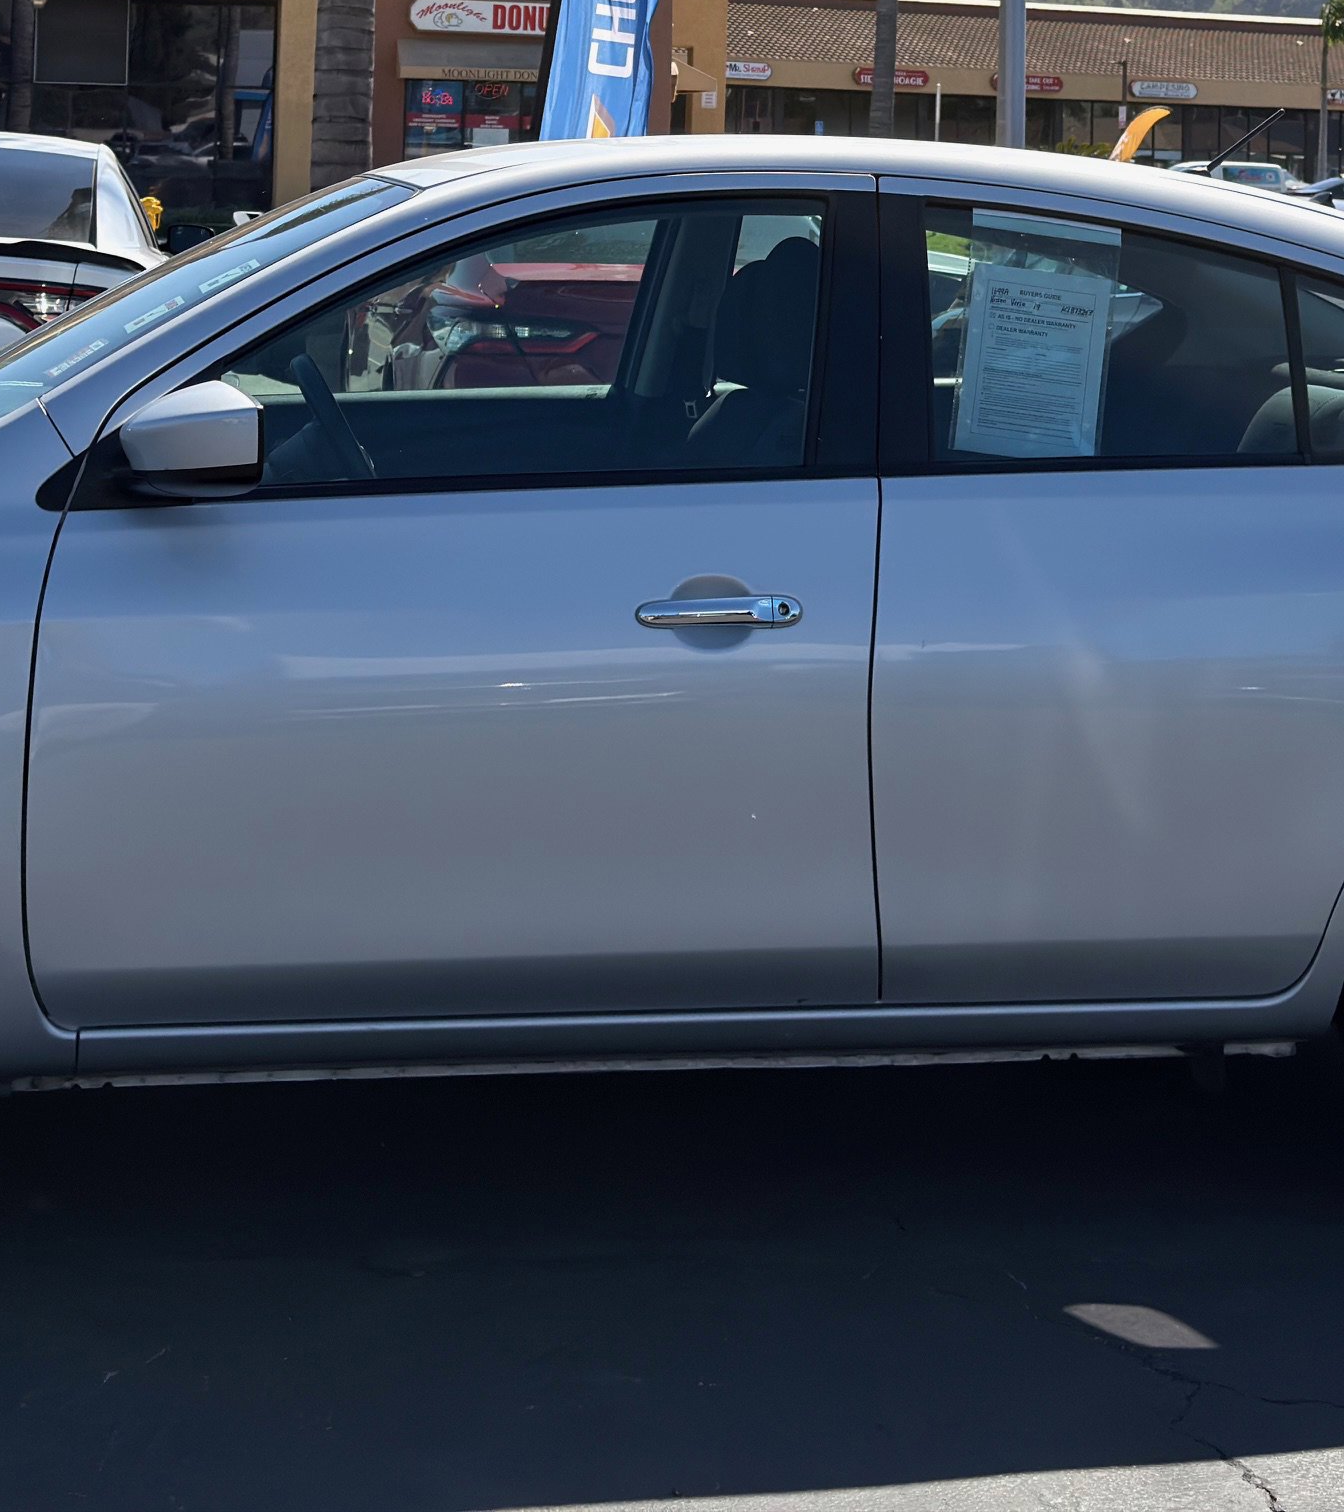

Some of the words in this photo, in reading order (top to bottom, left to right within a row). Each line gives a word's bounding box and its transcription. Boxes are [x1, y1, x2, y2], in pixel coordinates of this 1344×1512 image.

[416, 1, 488, 23] Moonlight
[492, 4, 551, 32] DONU
[441, 69, 511, 80] MOONLIGHT
[513, 70, 538, 82] DON
[476, 83, 509, 96] OPEN
[1019, 289, 1043, 299] BUYERS
[1043, 292, 1062, 301] GUIDE
[1023, 317, 1045, 325] DEALER
[1045, 319, 1077, 329] WARRANTY
[996, 325, 1018, 333] DEALER
[1017, 328, 1048, 337] WARRANTY
